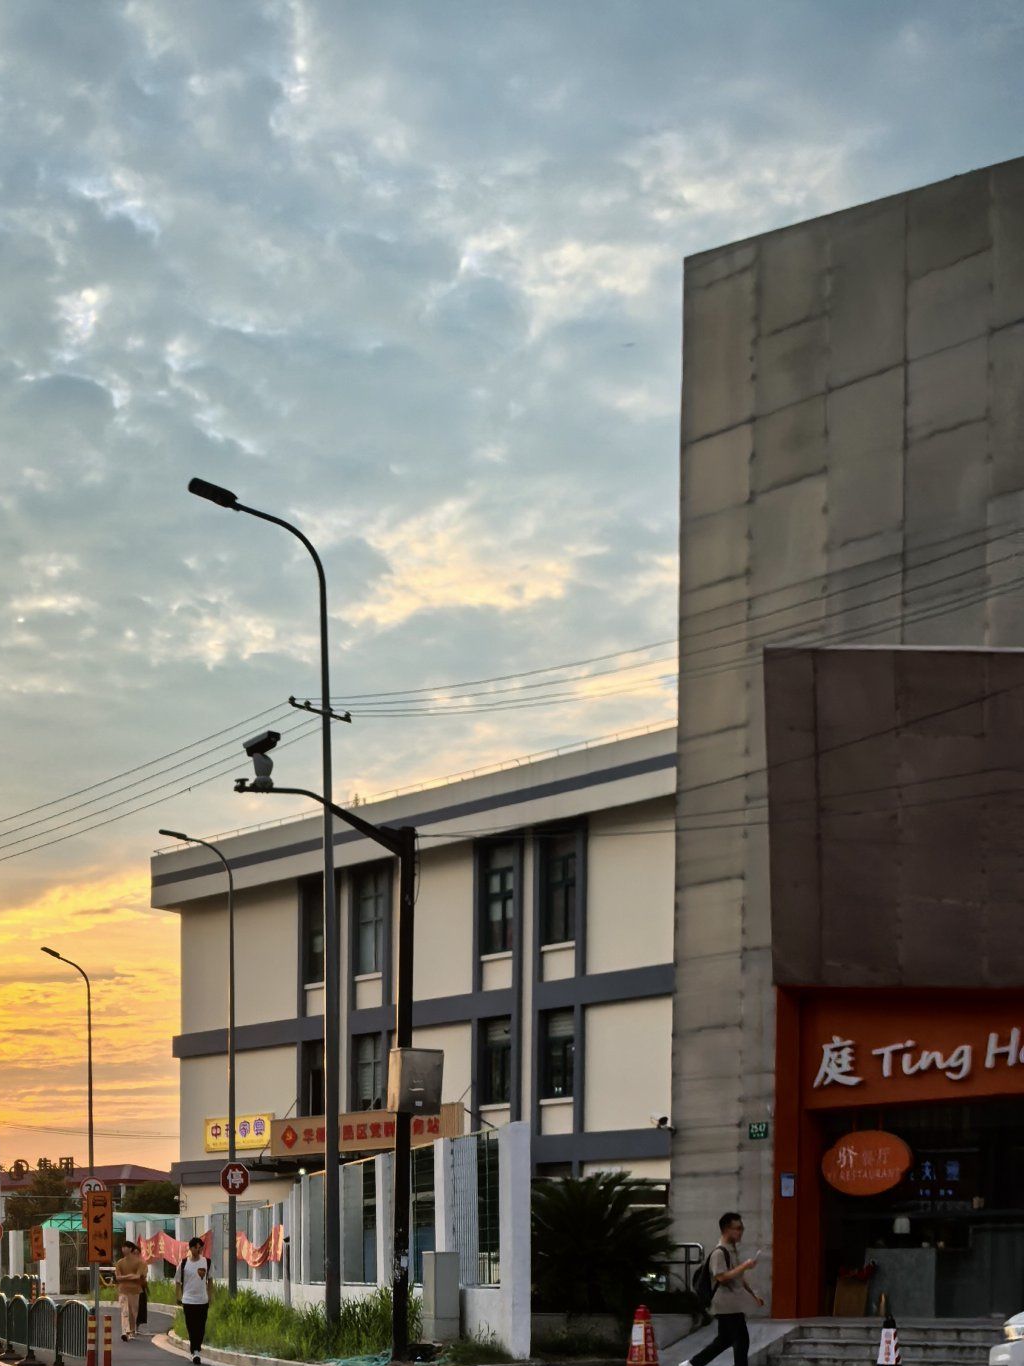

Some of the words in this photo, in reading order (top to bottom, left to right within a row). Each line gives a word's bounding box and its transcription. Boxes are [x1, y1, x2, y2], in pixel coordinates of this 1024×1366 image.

[812, 1034, 865, 1089] 庭
[871, 1039, 973, 1081] Ting
[984, 1026, 1024, 1069] H
[226, 1168, 244, 1189] 停
